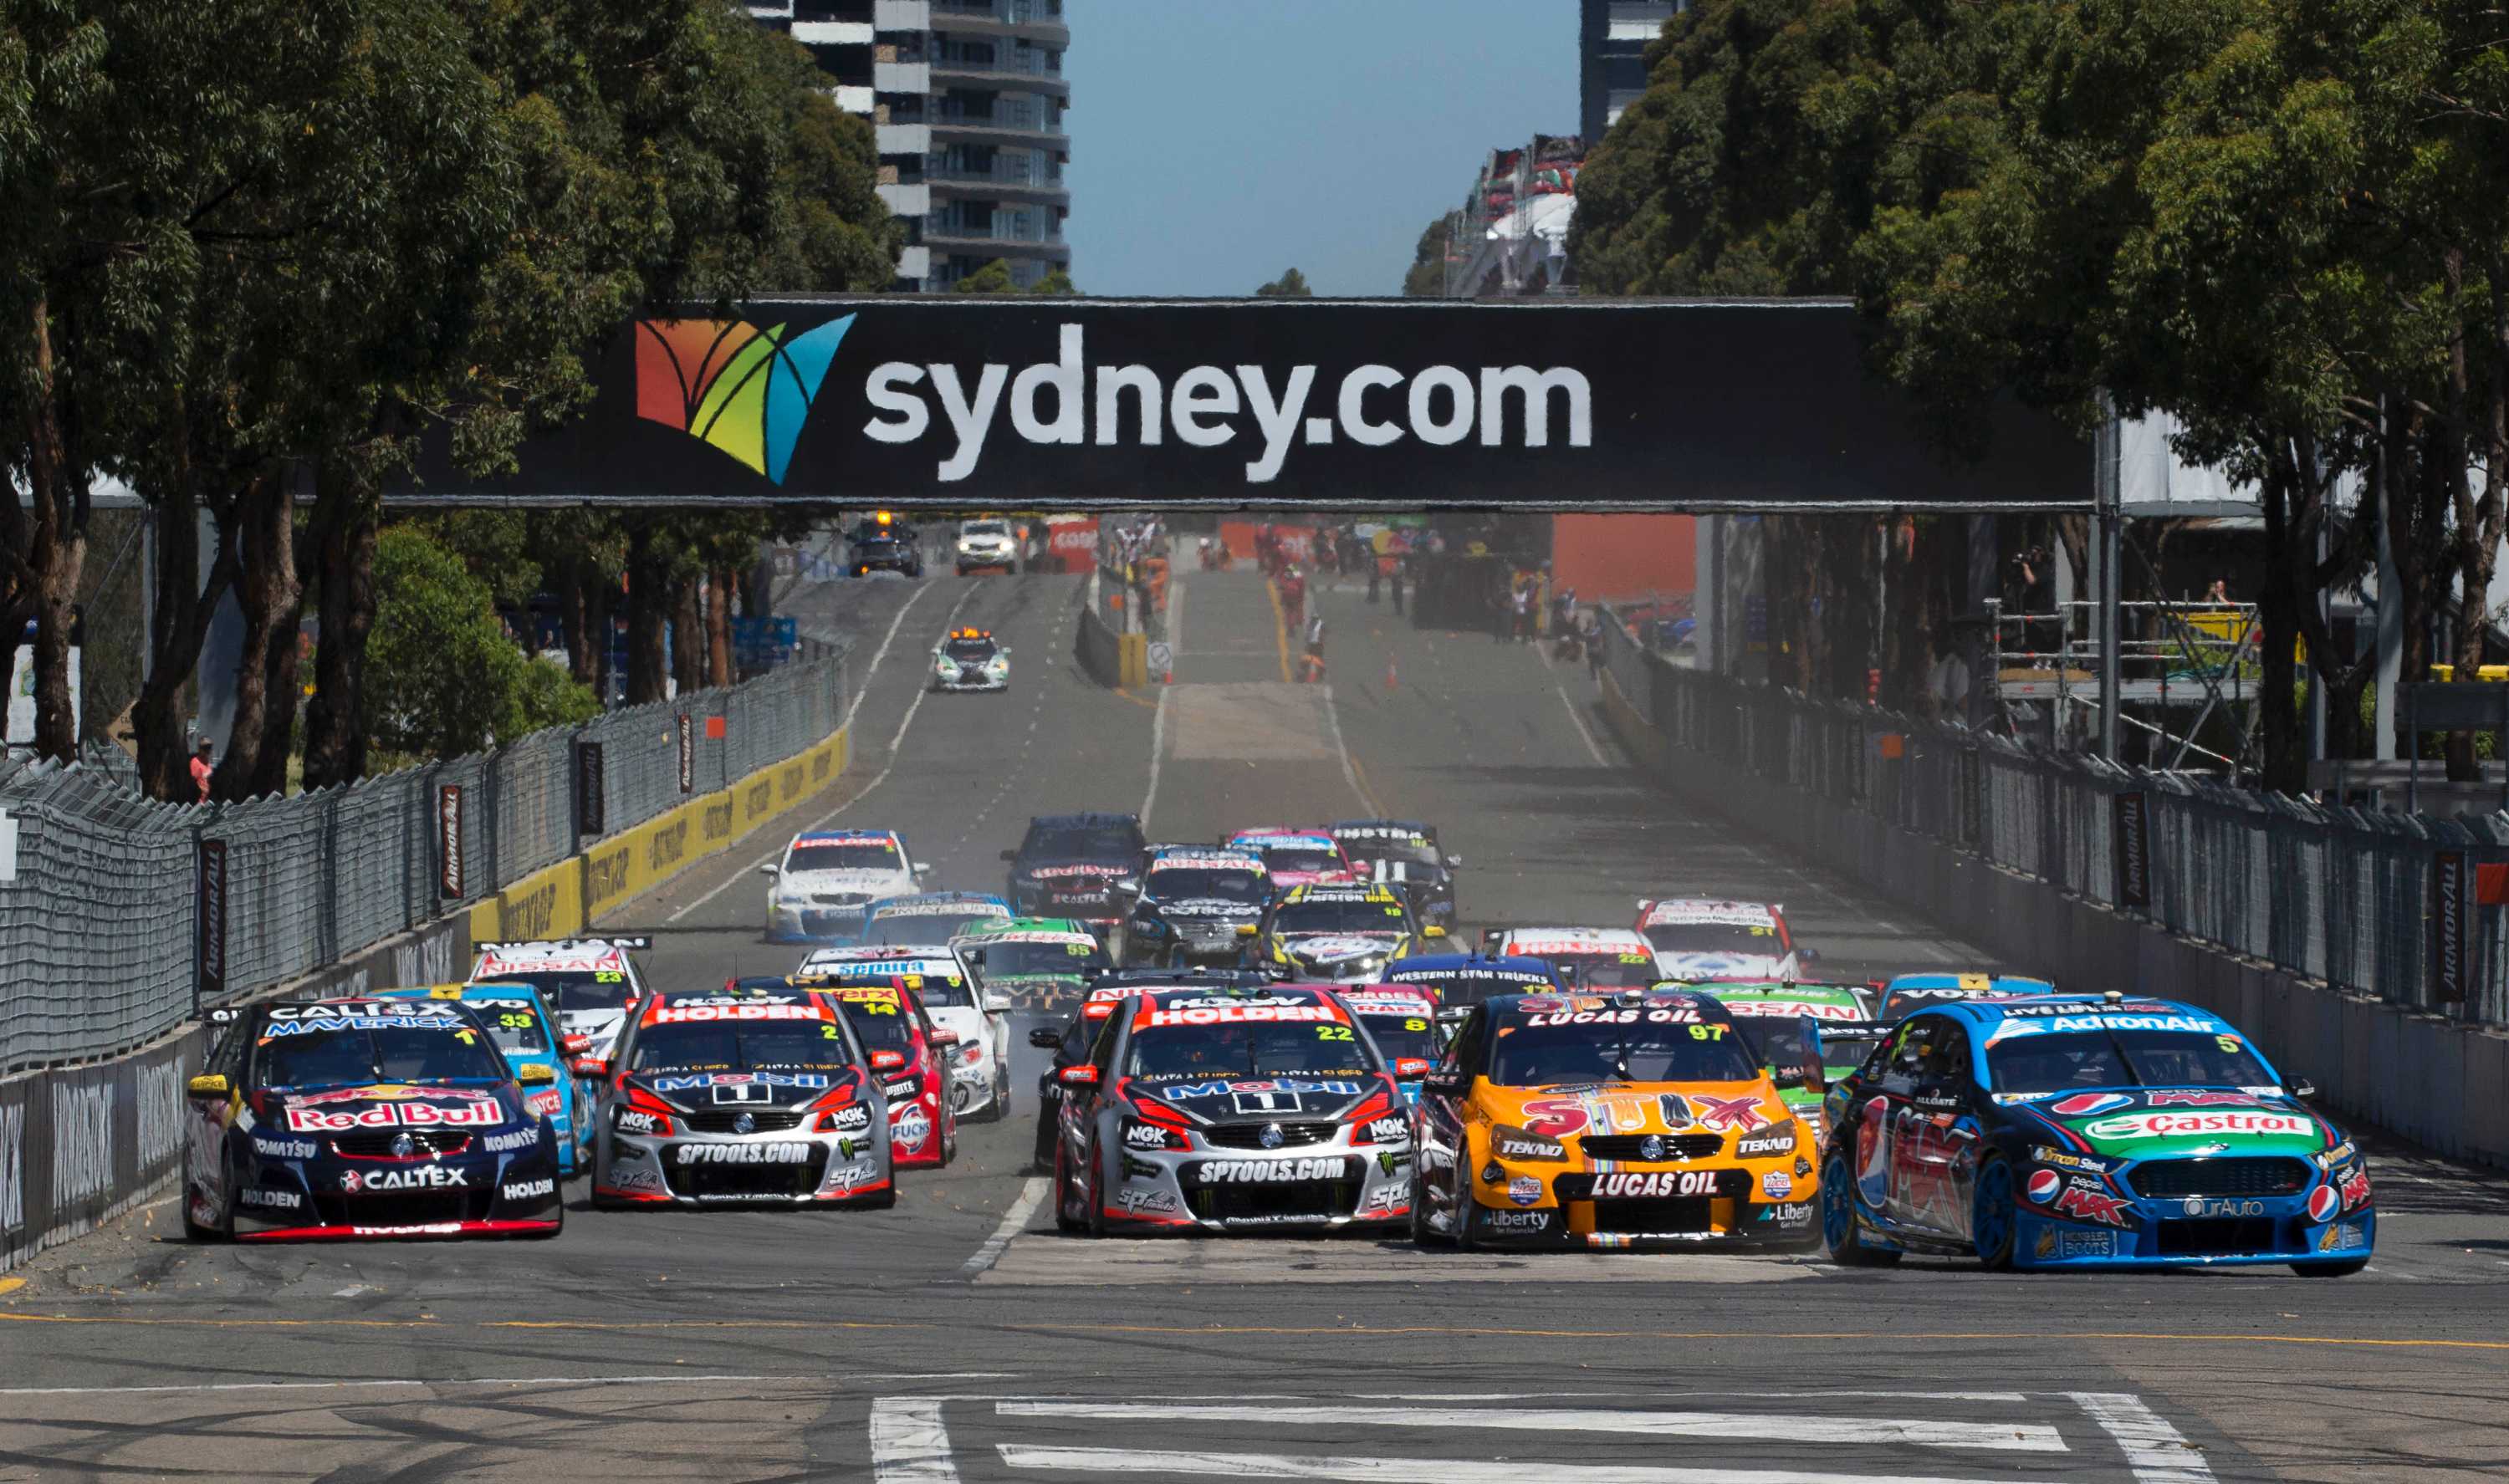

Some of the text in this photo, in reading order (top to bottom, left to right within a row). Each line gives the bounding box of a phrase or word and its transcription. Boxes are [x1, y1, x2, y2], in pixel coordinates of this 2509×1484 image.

[863, 322, 1592, 482] sydney.com
[482, 958, 620, 975] NISSAN
[595, 971, 622, 983] 23
[1392, 970, 1549, 983] WESTERN STAR TRUCKS
[269, 1003, 457, 1020] CALTEX
[657, 1006, 820, 1022] HOLDEN
[864, 1002, 897, 1016] 14
[1152, 1006, 1336, 1026] HOLDEN
[1527, 1009, 1702, 1027] LUCAS OIL
[264, 1016, 468, 1038] MAVERICK
[499, 1012, 534, 1028] 33
[1404, 1017, 1427, 1032] 8
[454, 1031, 475, 1045] 1
[820, 1026, 839, 1040] 2
[1316, 1027, 1355, 1042] 22
[1688, 1025, 1725, 1041] 97
[2215, 1036, 2241, 1053] 5
[285, 1096, 503, 1132] Red Bull
[620, 1113, 658, 1130] NGK
[831, 1106, 867, 1125] NGK
[1368, 1117, 1409, 1137] NGK
[2146, 1114, 2303, 1133] Castrol
[1127, 1125, 1168, 1144] NGK
[677, 1142, 810, 1165] SPTOOLS.COM
[1501, 1139, 1564, 1157] TEKNO
[1738, 1136, 1794, 1154] TEKNO
[1198, 1157, 1346, 1183] SPTOOLS.COM
[2079, 1157, 2107, 1172] Steel
[364, 1167, 468, 1190] CALTEX
[1592, 1171, 1718, 1196] LUCAS OIL
[2069, 1175, 2105, 1190] pepsi
[241, 1188, 302, 1208] HOLDEN
[503, 1178, 554, 1201] HOLDEN
[1491, 1211, 1549, 1229] Liberty
[1776, 1203, 1814, 1223] Liberty
